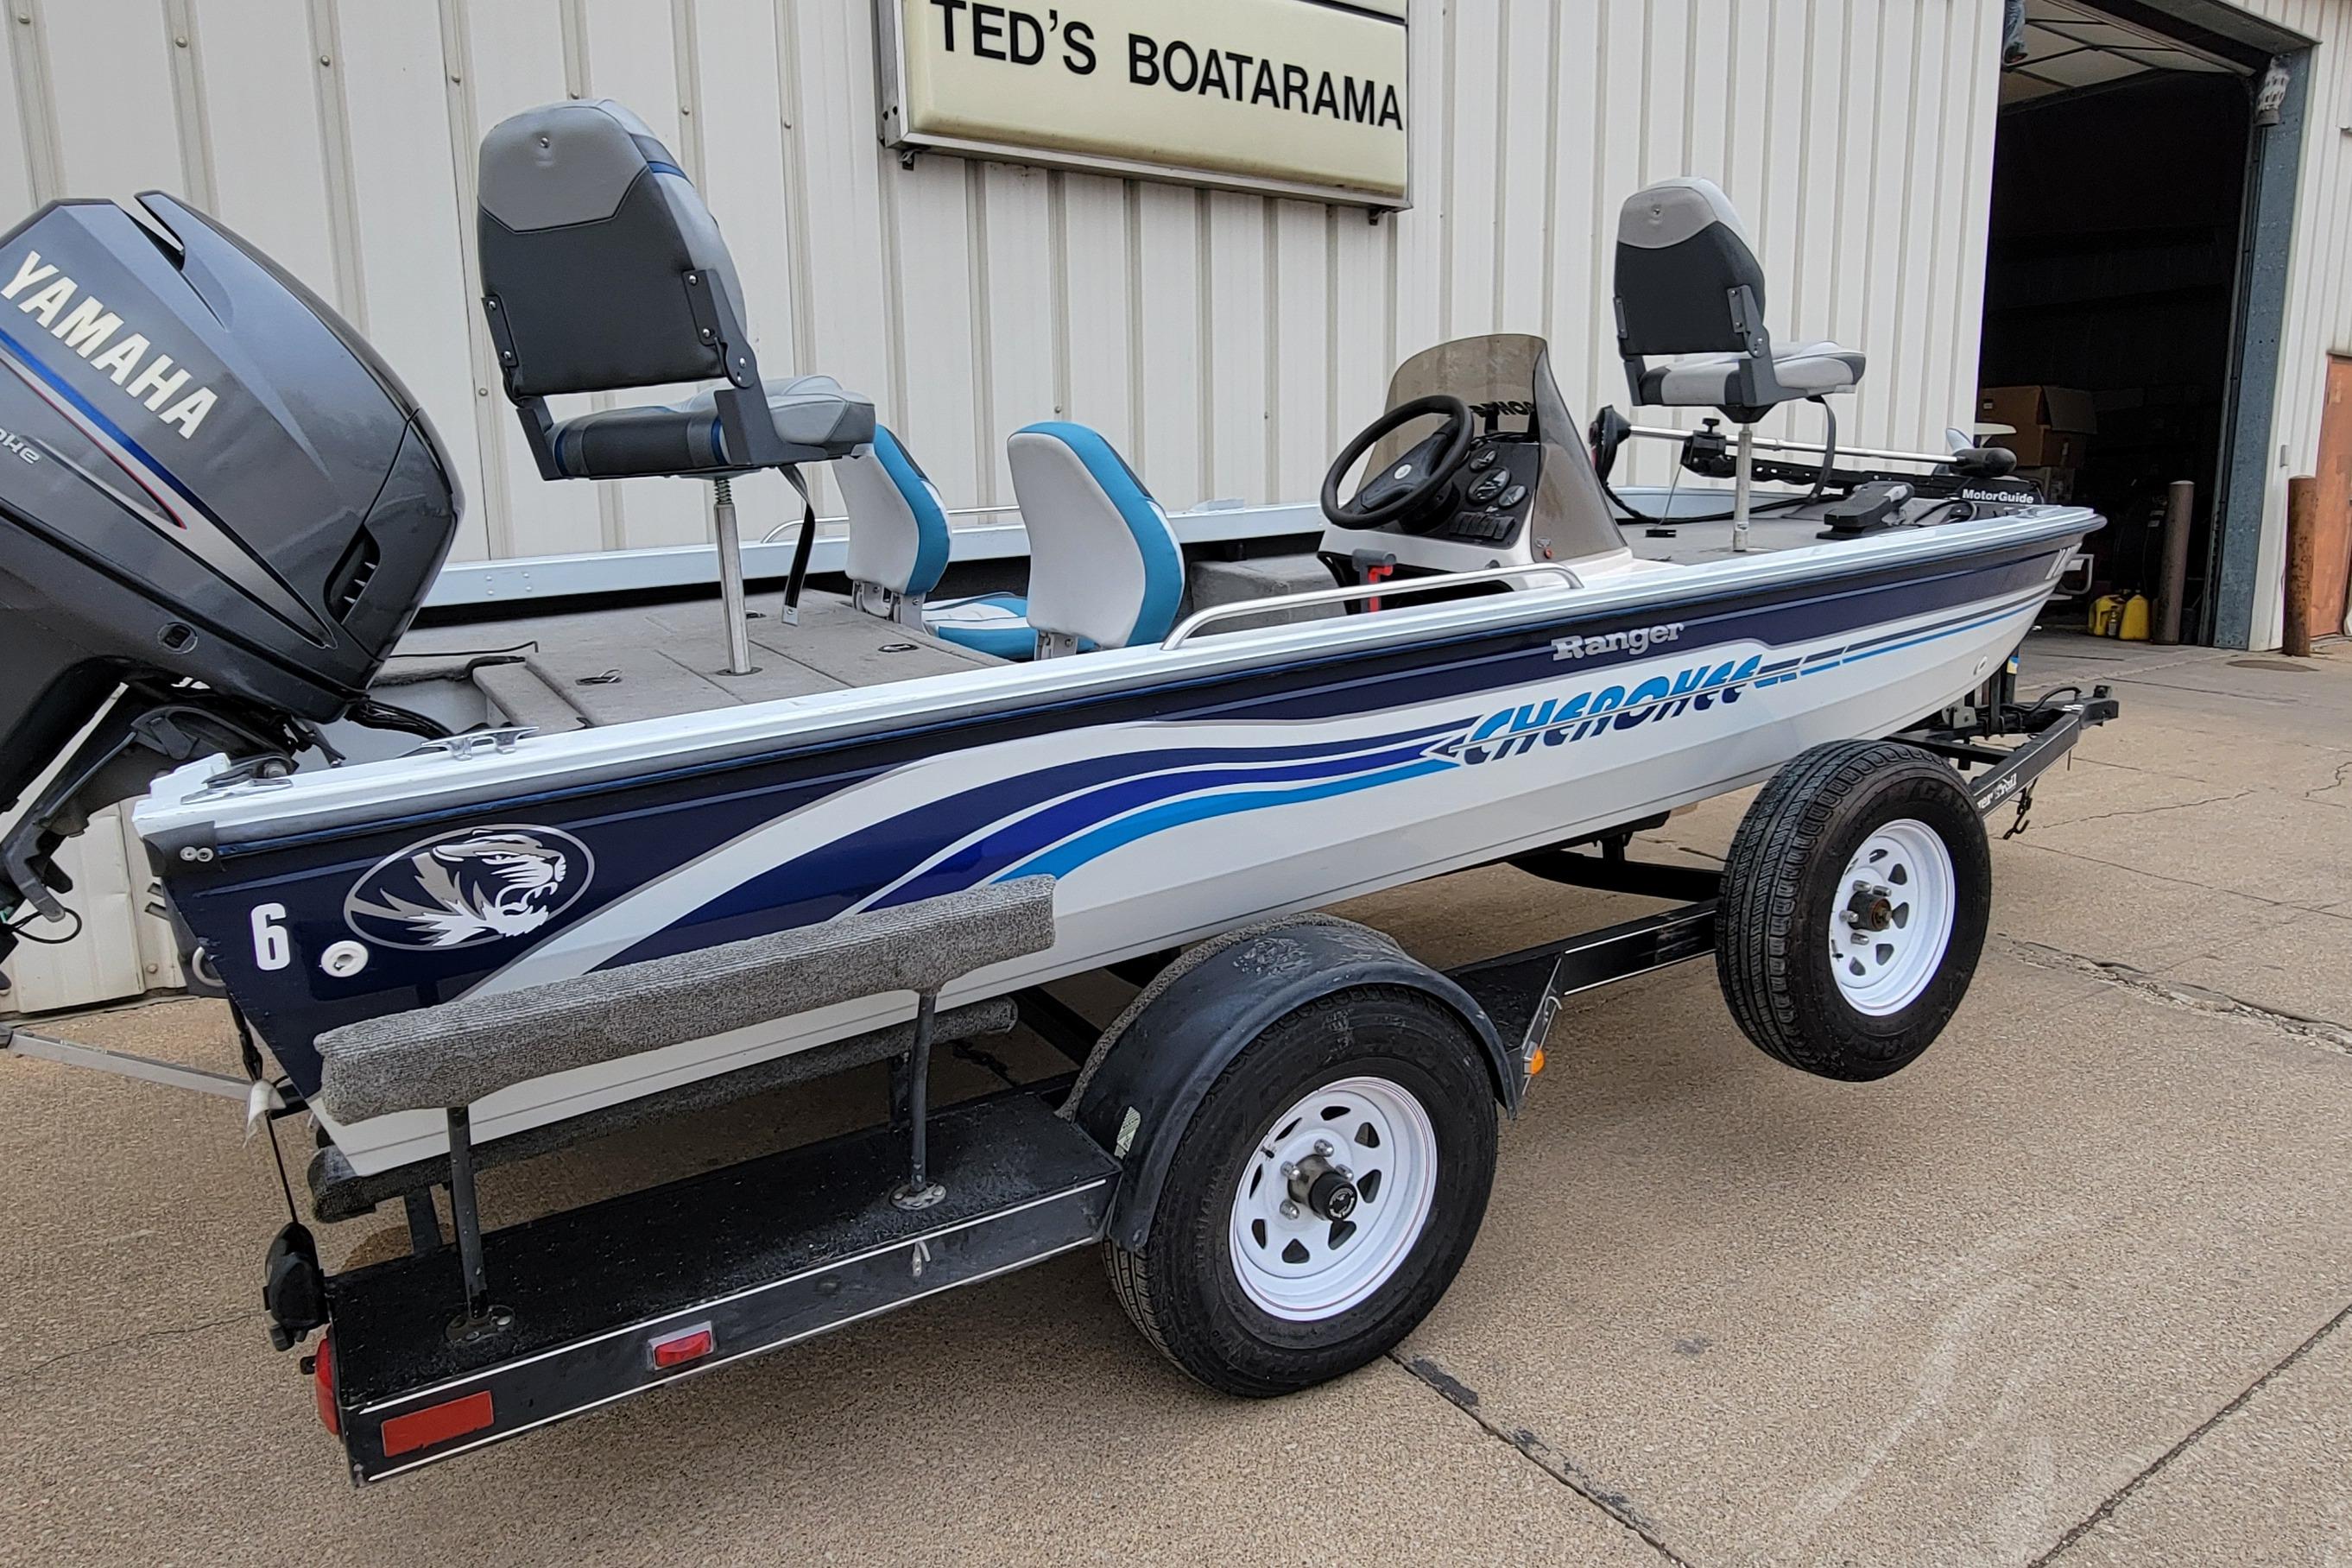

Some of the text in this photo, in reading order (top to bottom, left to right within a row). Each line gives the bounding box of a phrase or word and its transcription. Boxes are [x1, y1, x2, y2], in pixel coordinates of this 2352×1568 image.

[930, 0, 1404, 131] TED'S BOATARAMA
[1, 250, 218, 439] YAMAHA
[1962, 489, 2034, 504] MotorGuide
[1551, 622, 1685, 661] Ranger
[1464, 654, 1763, 765] CHEROKEE
[250, 902, 291, 971] 6
